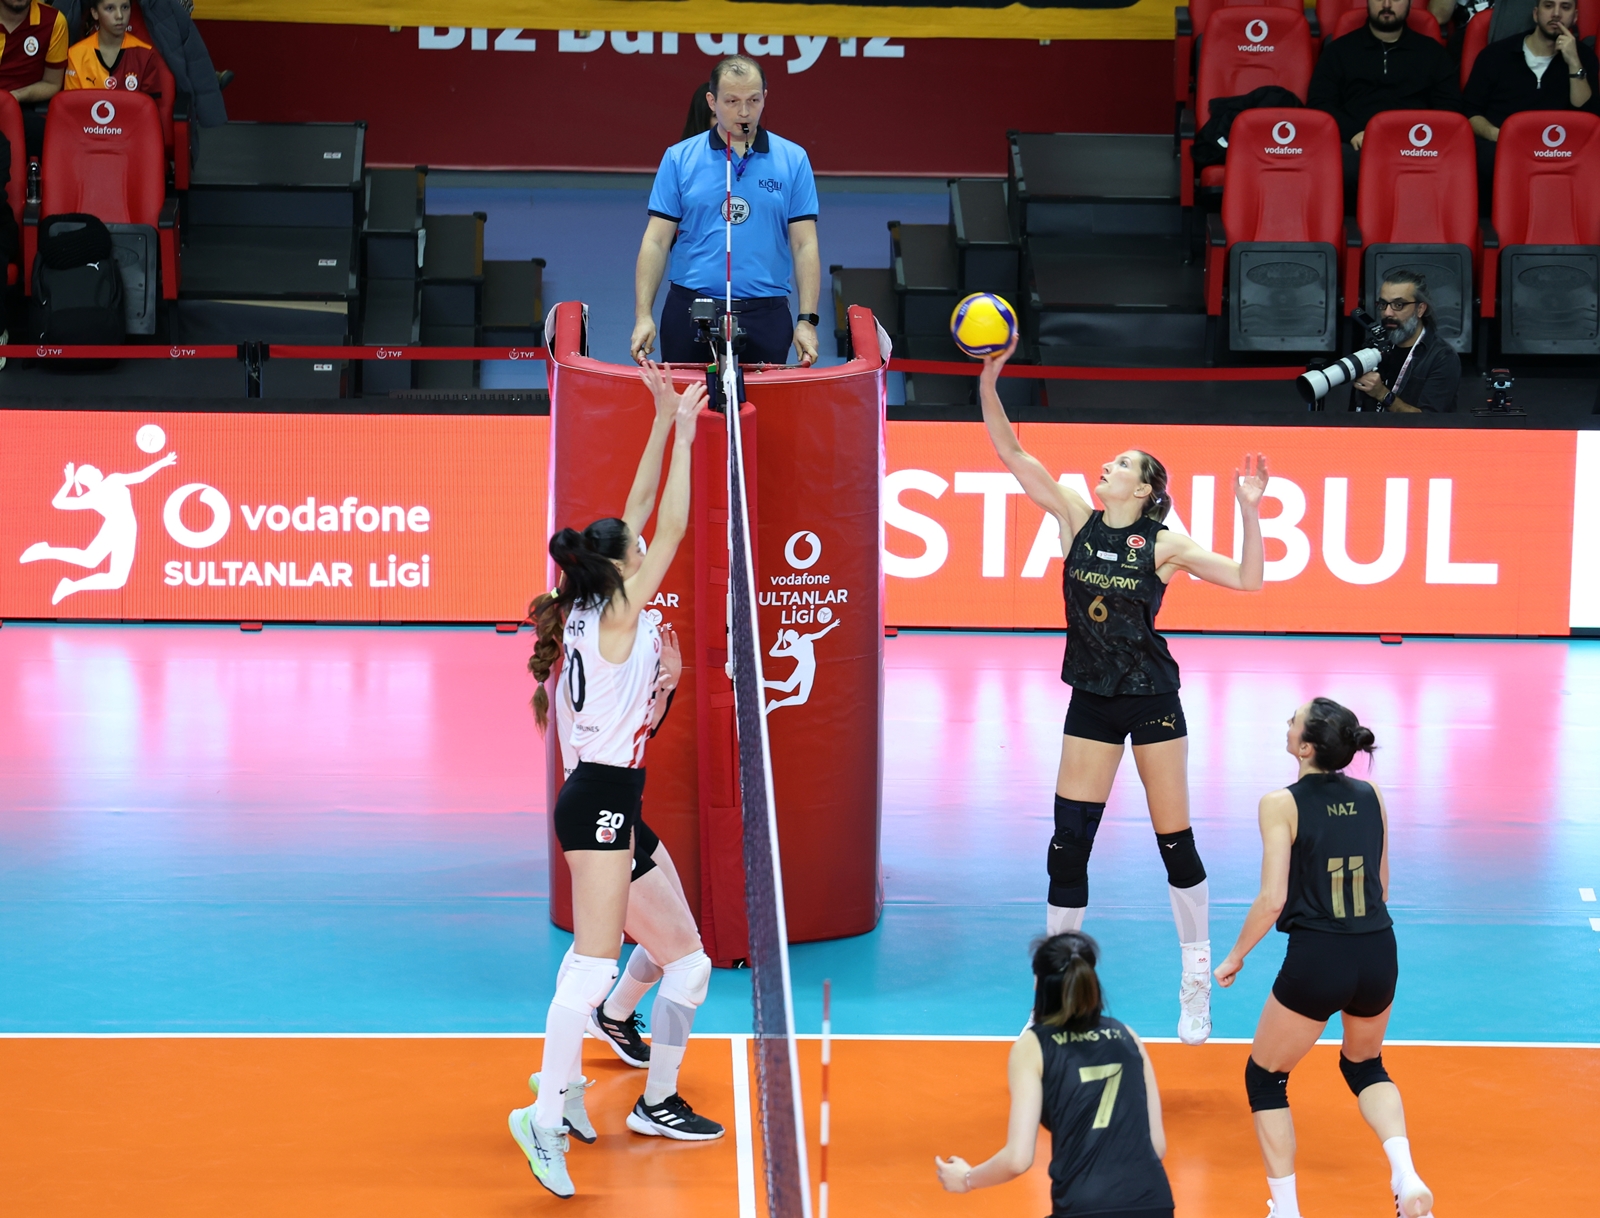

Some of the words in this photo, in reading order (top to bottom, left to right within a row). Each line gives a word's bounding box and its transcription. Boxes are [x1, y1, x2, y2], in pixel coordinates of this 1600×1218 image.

[1237, 44, 1274, 52] vodafone
[83, 125, 122, 135] vodafone
[1264, 146, 1303, 155] vodafone
[1400, 149, 1438, 157] vodafone
[1533, 149, 1572, 158] vodafone
[240, 496, 431, 533] vodafone
[164, 560, 353, 587] SULTANLAR
[369, 553, 431, 588] LİGİ
[770, 573, 831, 586] vodafone
[781, 604, 815, 625] LİGİ
[1088, 595, 1108, 623] 6
[1326, 801, 1358, 817] NAZ
[596, 810, 625, 829] 20
[1327, 855, 1366, 918] 11
[1051, 1030, 1100, 1046] WANG
[1079, 1063, 1122, 1129] 7
